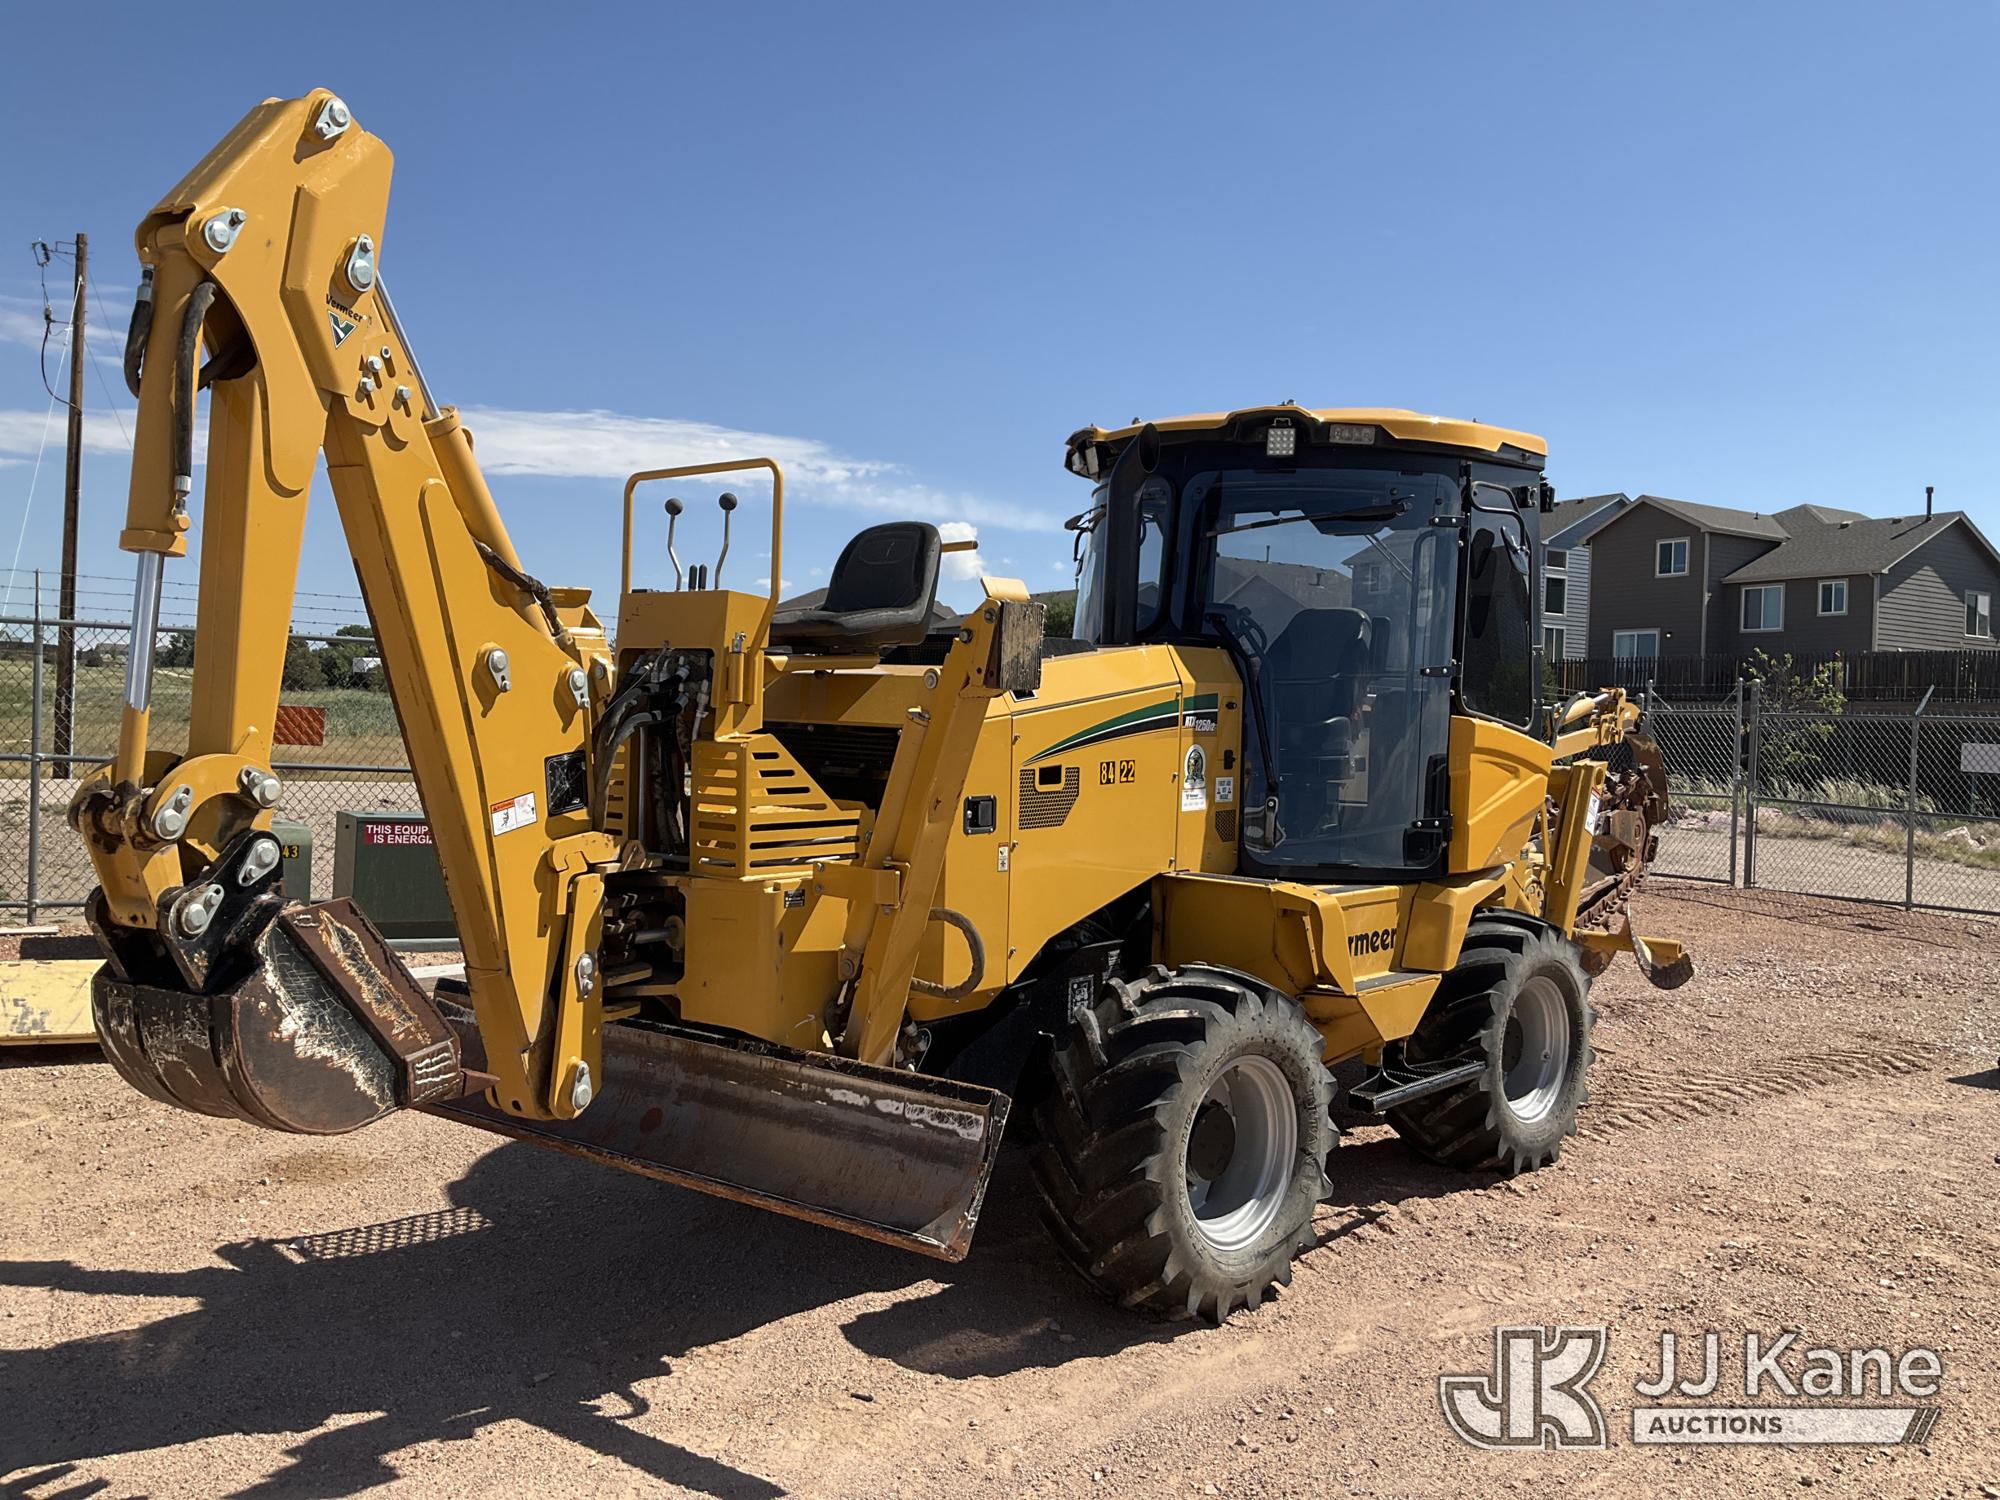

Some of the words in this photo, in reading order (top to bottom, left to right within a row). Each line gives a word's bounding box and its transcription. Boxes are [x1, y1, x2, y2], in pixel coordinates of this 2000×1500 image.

[326, 293, 363, 322] Vermeer
[366, 824, 392, 834] THIS
[373, 834, 385, 844] IS
